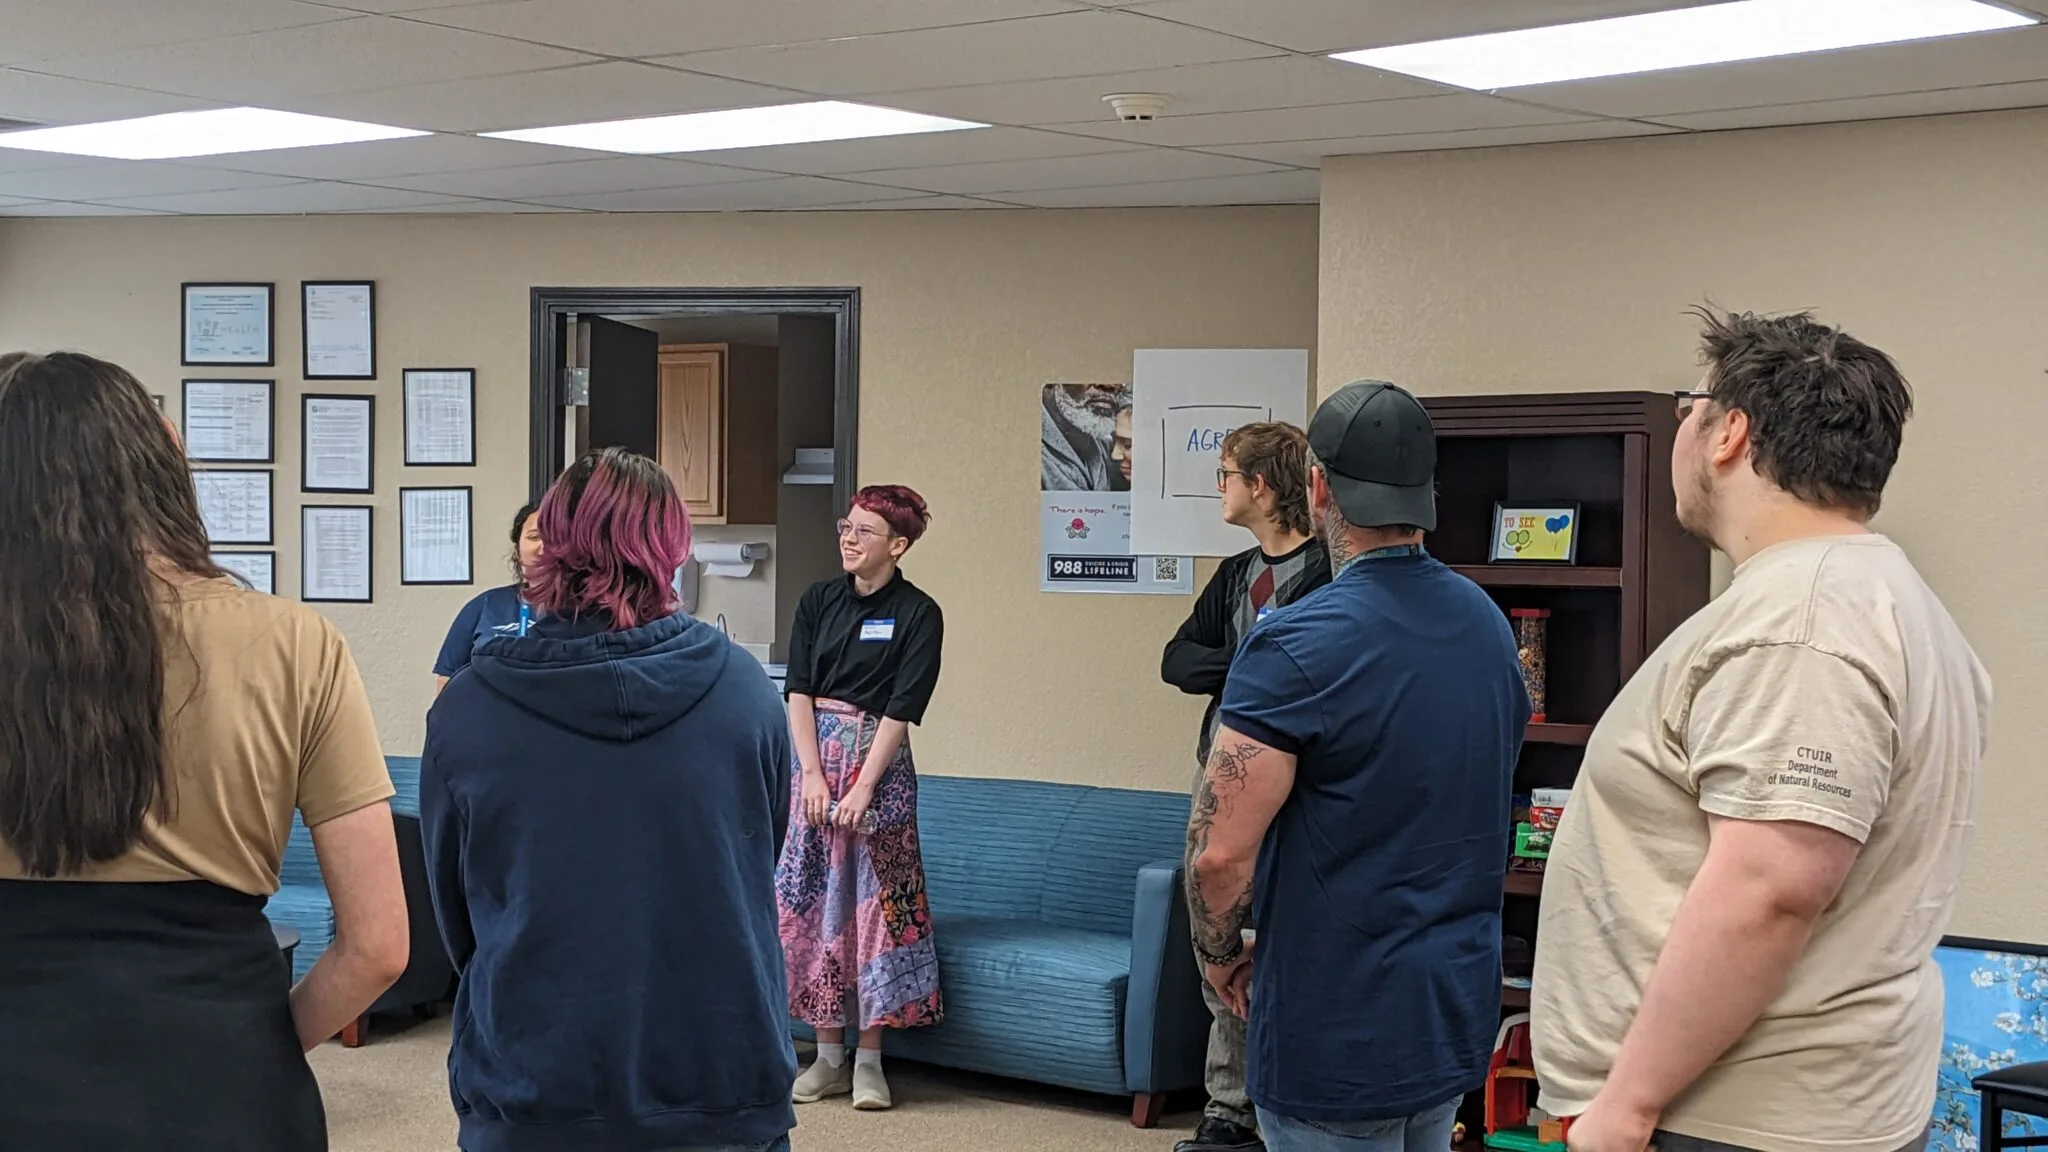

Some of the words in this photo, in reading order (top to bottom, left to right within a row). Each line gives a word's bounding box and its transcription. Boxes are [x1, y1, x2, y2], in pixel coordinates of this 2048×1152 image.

[1049, 505, 1075, 513] There
[1504, 517, 1515, 528] TO
[1519, 516, 1535, 528] SEE
[1054, 560, 1082, 574] 988
[1084, 567, 1129, 575] LIFELINE
[1797, 747, 1832, 763] CTUIR
[1788, 760, 1838, 780] Department
[1768, 774, 1777, 785] of
[1779, 774, 1810, 788] Natural
[1812, 778, 1852, 798] Resources
